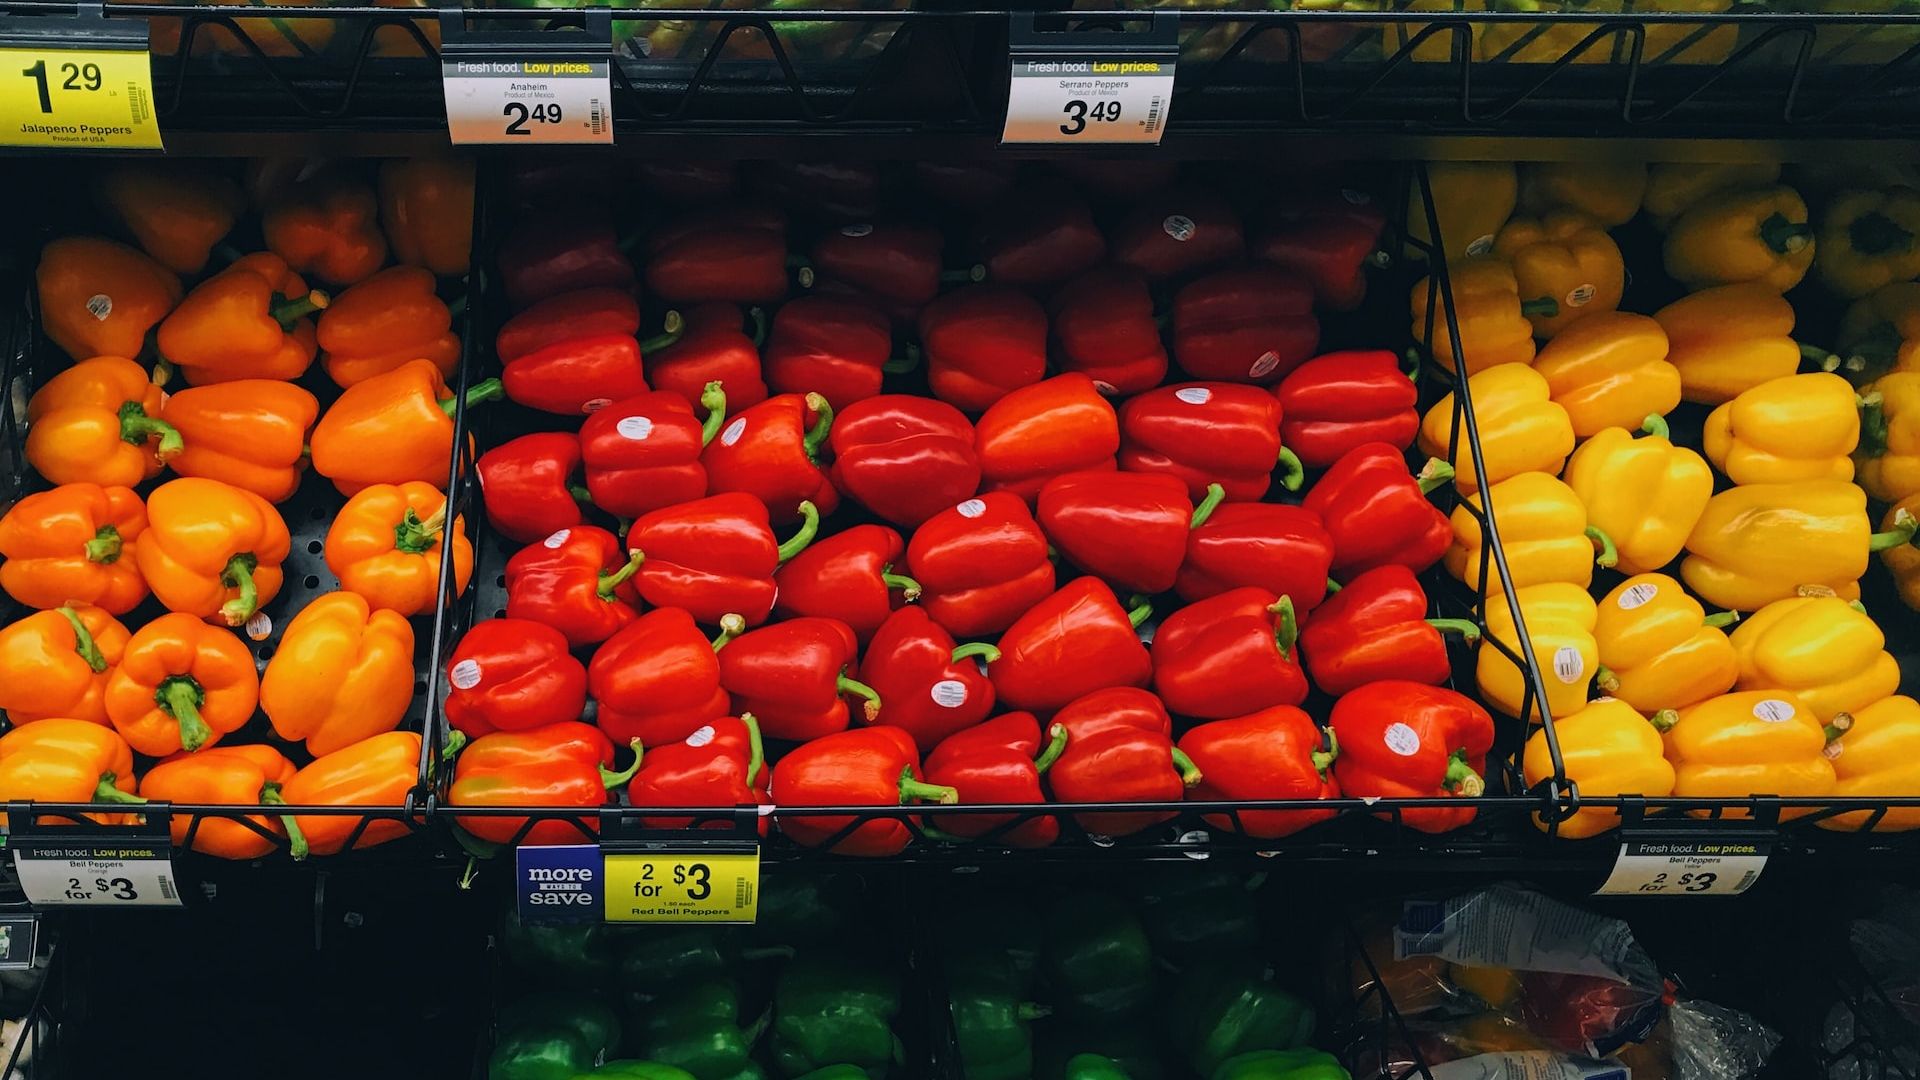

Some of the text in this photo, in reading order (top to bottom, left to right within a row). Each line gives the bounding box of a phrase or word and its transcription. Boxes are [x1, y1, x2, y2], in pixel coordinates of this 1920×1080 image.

[457, 61, 593, 75] Fresh food. Low prices.
[1027, 61, 1161, 75] Fresh food. Low prices.
[510, 83, 548, 91] Anaheim
[1059, 80, 1129, 90] Serrano Peppers
[20, 123, 132, 136] Jalapeno Peppers
[53, 135, 79, 143] Product
[33, 849, 156, 858] Fresh food. Low prices.
[1639, 844, 1757, 854] Fresh food. Low prices.
[88, 861, 124, 869] Peppers
[528, 868, 593, 881] more
[641, 863, 654, 880] 2
[1653, 873, 1668, 883] 2
[68, 878, 82, 890] 2
[1639, 883, 1669, 892] for
[634, 882, 663, 897] for
[65, 890, 93, 900] for
[529, 892, 593, 905] save
[683, 908, 730, 916] Peppers
